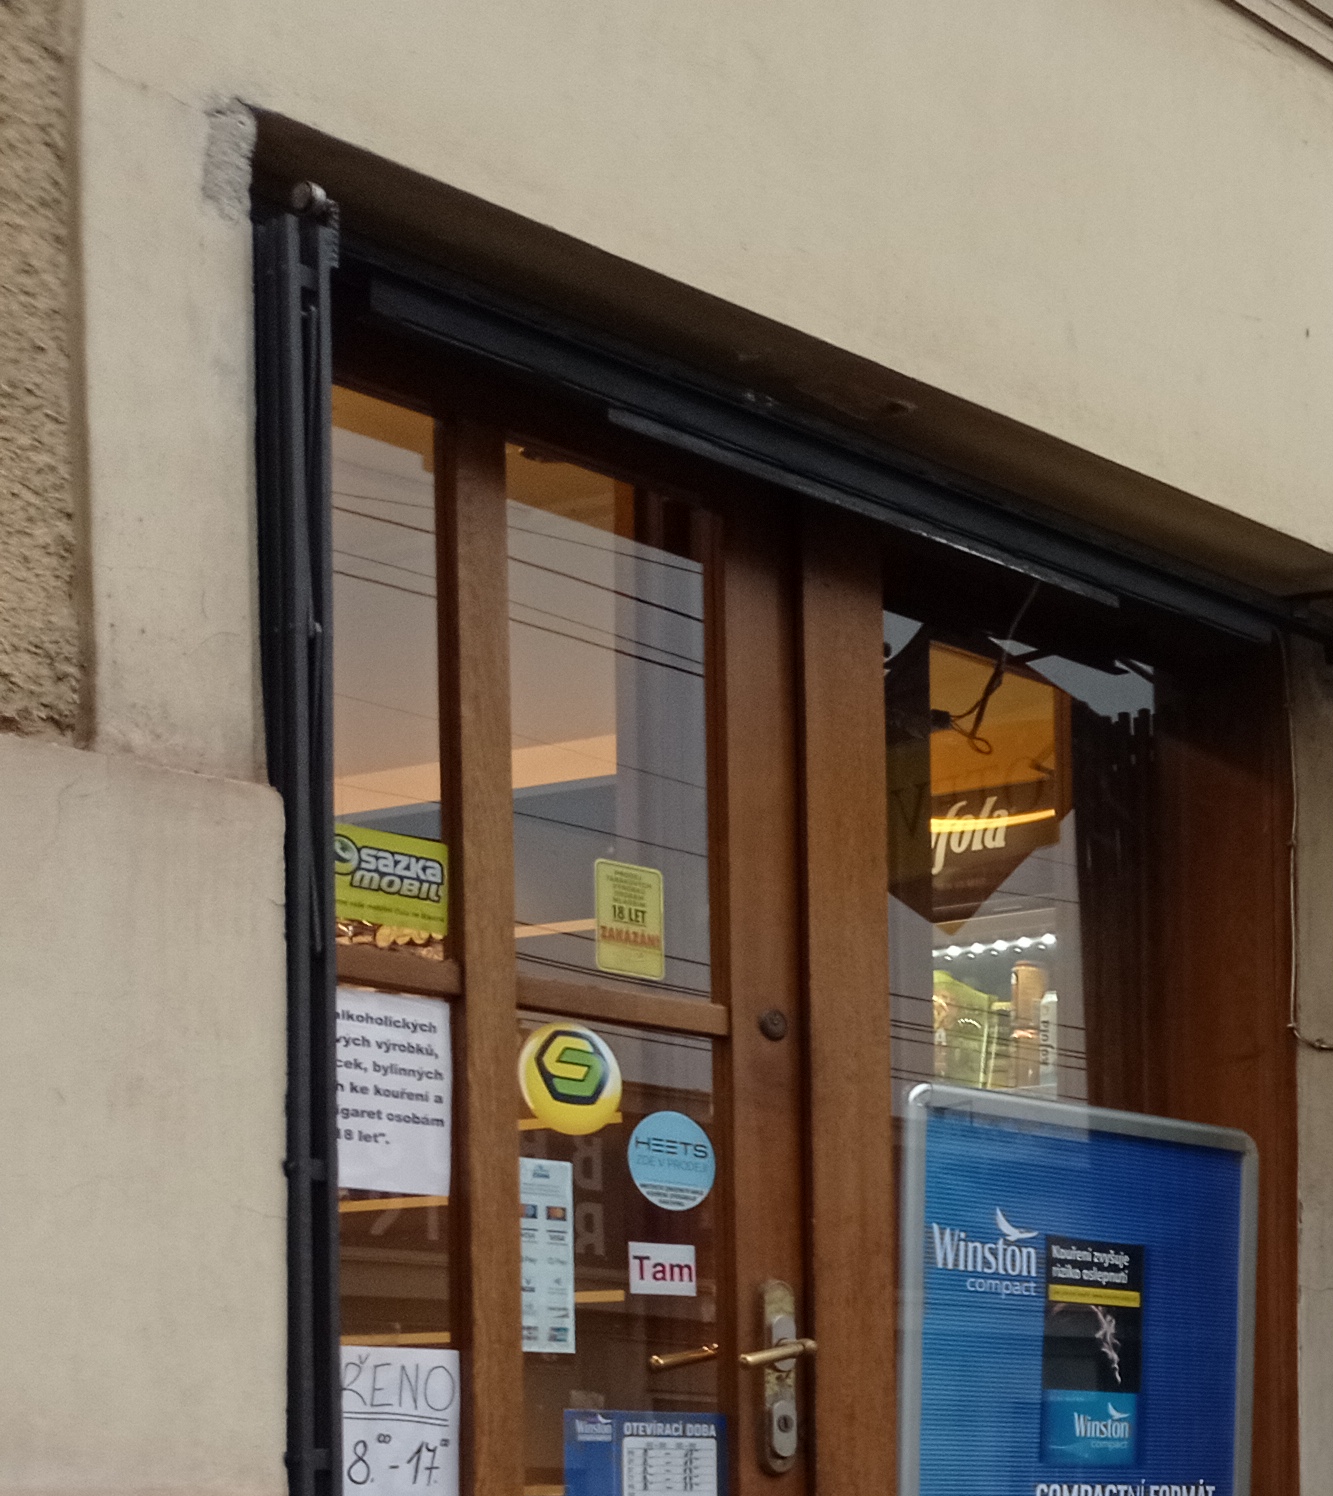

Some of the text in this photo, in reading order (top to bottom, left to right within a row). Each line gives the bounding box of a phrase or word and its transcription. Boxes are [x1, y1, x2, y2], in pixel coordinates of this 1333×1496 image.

[628, 908, 647, 923] LET
[372, 1060, 444, 1081] bylinných
[373, 1085, 429, 1102] kouření
[635, 1135, 708, 1158] HEETS
[932, 1222, 1037, 1277] Winston
[633, 1255, 693, 1282] Tam
[966, 1278, 1037, 1299] compact
[624, 1420, 717, 1437] OTEVÍRACÍ DOBA
[1074, 1412, 1130, 1438] Winston
